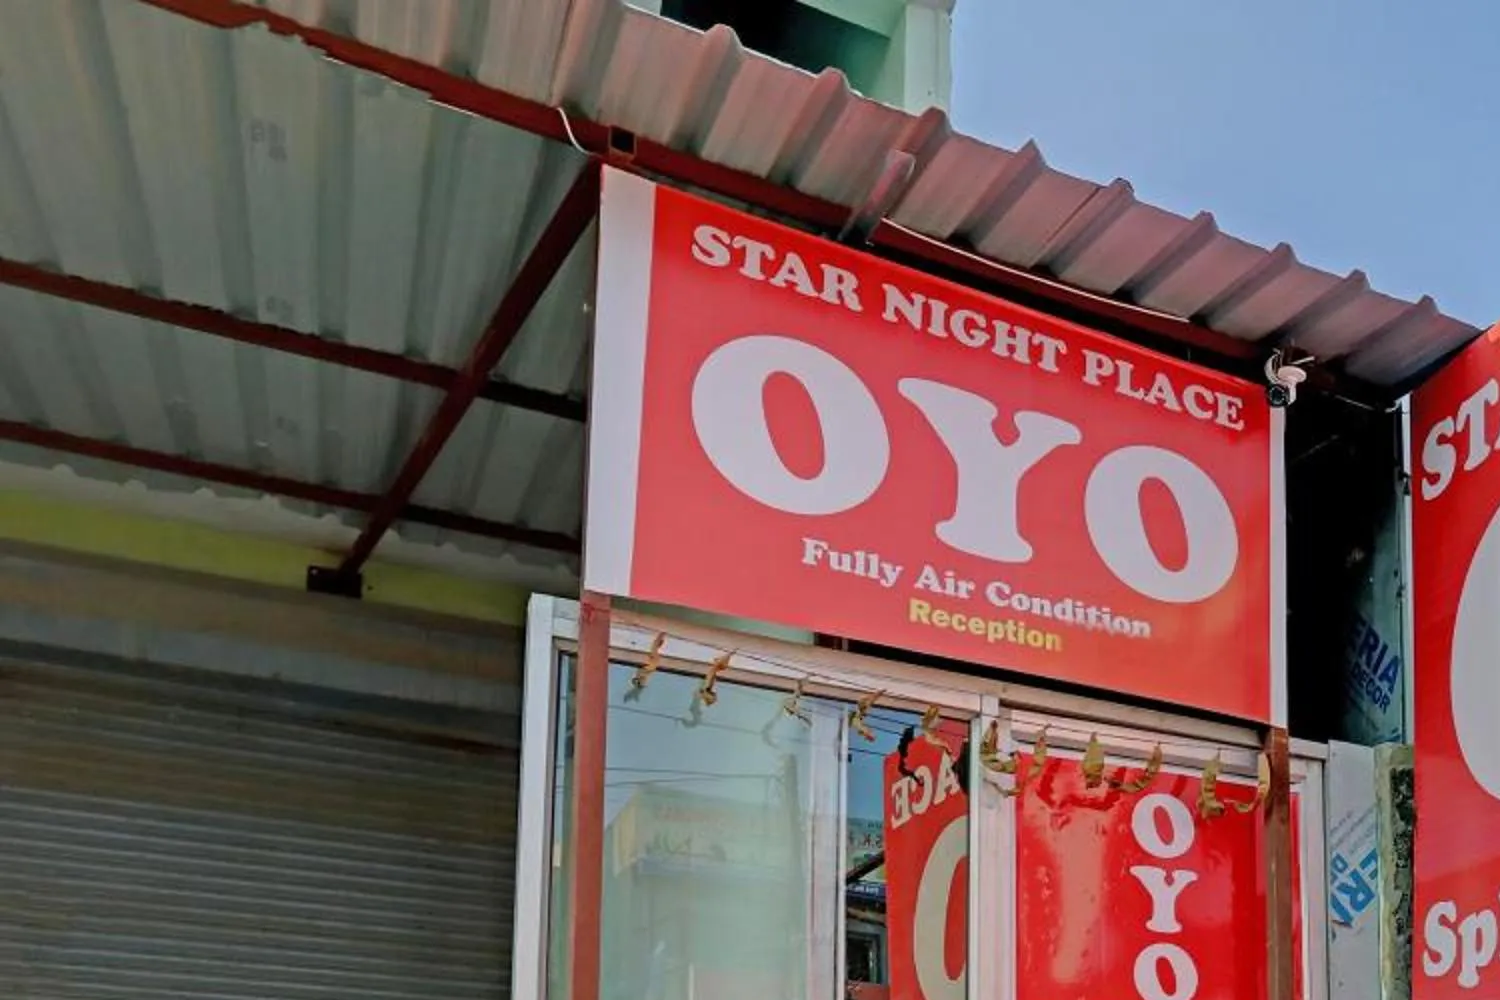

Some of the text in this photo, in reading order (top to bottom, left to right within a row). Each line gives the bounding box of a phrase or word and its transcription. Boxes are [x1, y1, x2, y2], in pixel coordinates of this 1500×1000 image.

[692, 224, 1245, 431] STAR NIGHT PLACE
[691, 335, 1239, 603] OYO
[801, 537, 1152, 639] Fully Air Condition
[908, 598, 1063, 651] Reception
